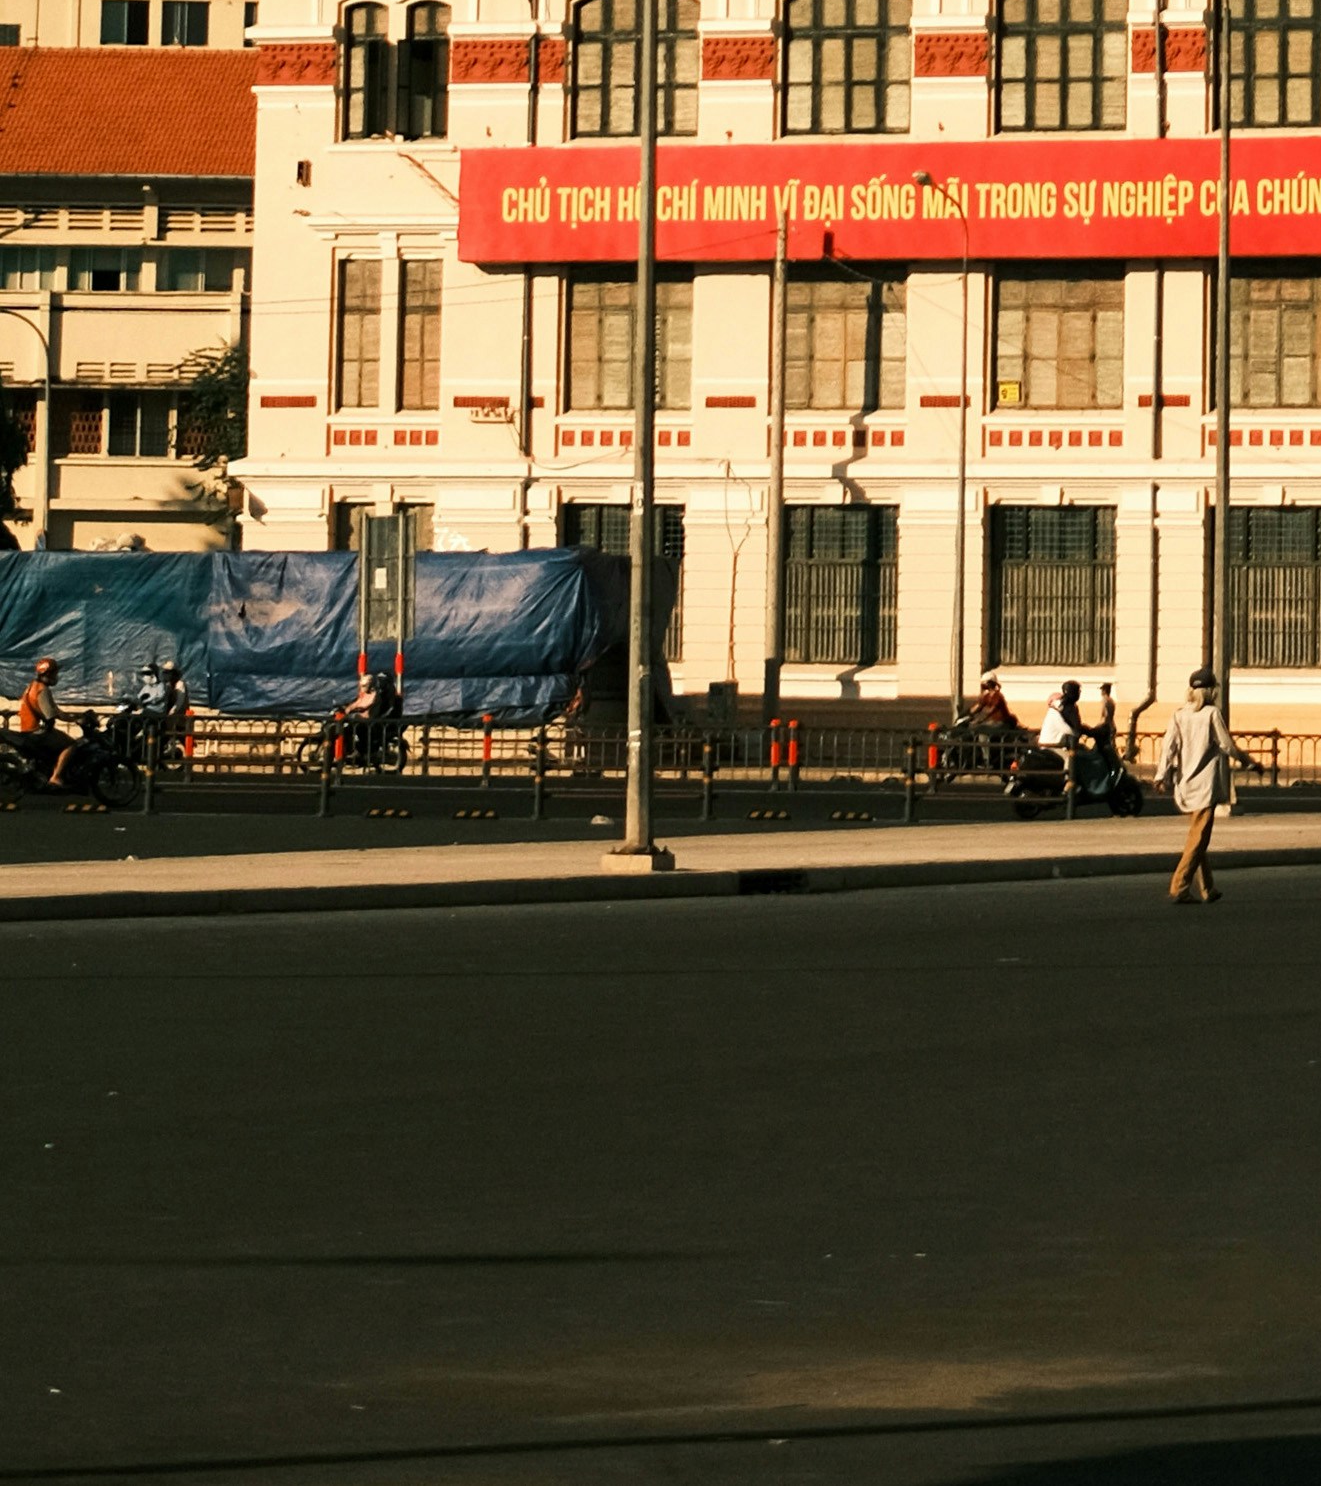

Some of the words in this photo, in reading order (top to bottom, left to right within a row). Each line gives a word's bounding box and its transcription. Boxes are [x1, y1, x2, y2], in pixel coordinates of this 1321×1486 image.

[502, 176, 551, 223] CHỦ
[556, 186, 611, 229] TỊCH
[656, 179, 699, 222] CHÍ
[703, 185, 768, 221] MINH
[773, 179, 800, 221] VĨ
[803, 184, 844, 227] ĐẠI
[850, 174, 916, 221] SỐNG
[922, 177, 968, 220] MÃI
[974, 182, 1058, 220] TRONG
[1063, 180, 1098, 225] SỰ
[1103, 174, 1194, 224] NGHIỆP
